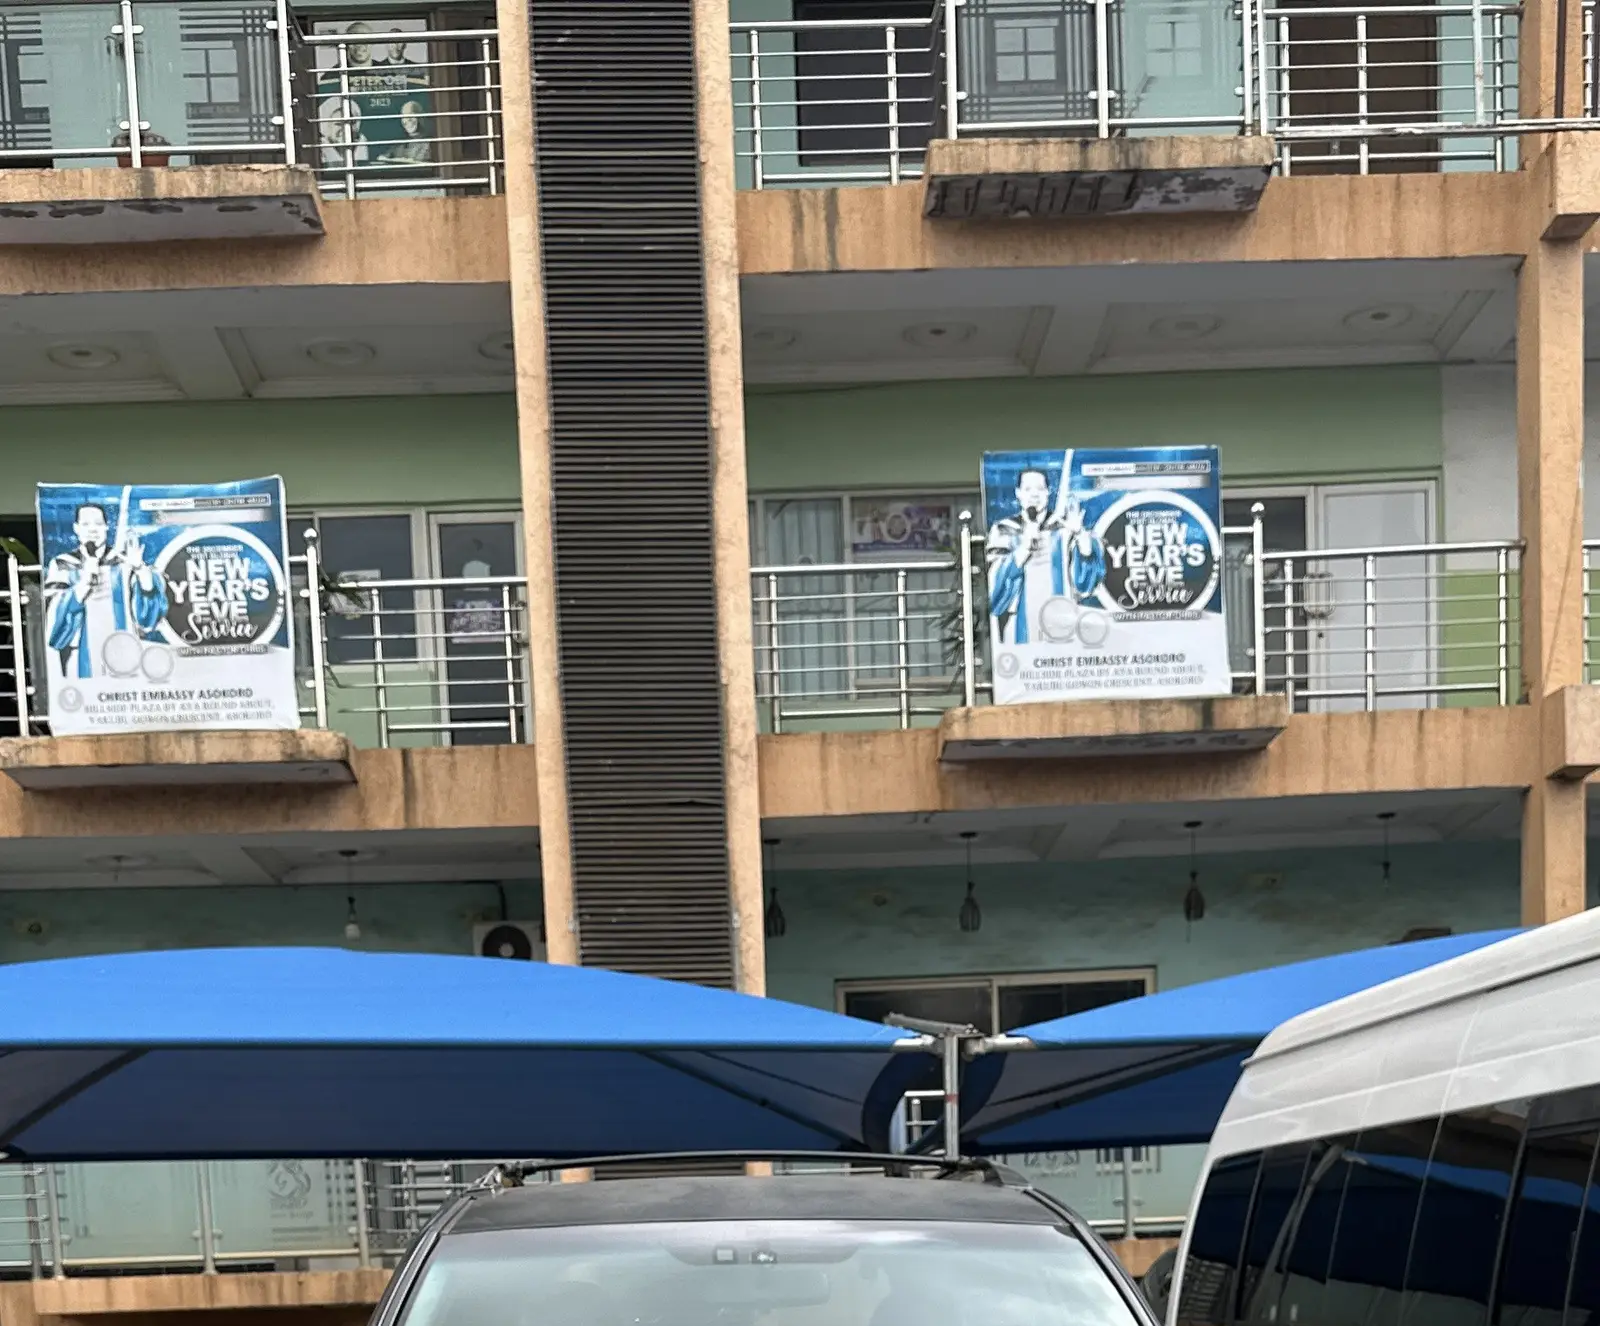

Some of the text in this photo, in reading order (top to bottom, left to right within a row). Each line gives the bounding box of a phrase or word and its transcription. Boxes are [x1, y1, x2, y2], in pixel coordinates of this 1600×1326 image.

[1125, 522, 1188, 546] NEW
[1106, 543, 1205, 569] YEAR'S
[186, 557, 251, 581] NEW
[1129, 566, 1185, 587] EVE
[167, 577, 270, 603] YEAR'S
[1118, 578, 1194, 609] Service
[193, 601, 249, 622] EVE
[182, 613, 258, 643] Service
[1033, 657, 1073, 668] CHRIST
[1076, 655, 1129, 666] EMBASSY
[97, 691, 137, 702] CHRIST
[141, 690, 195, 700] EMBASSY
